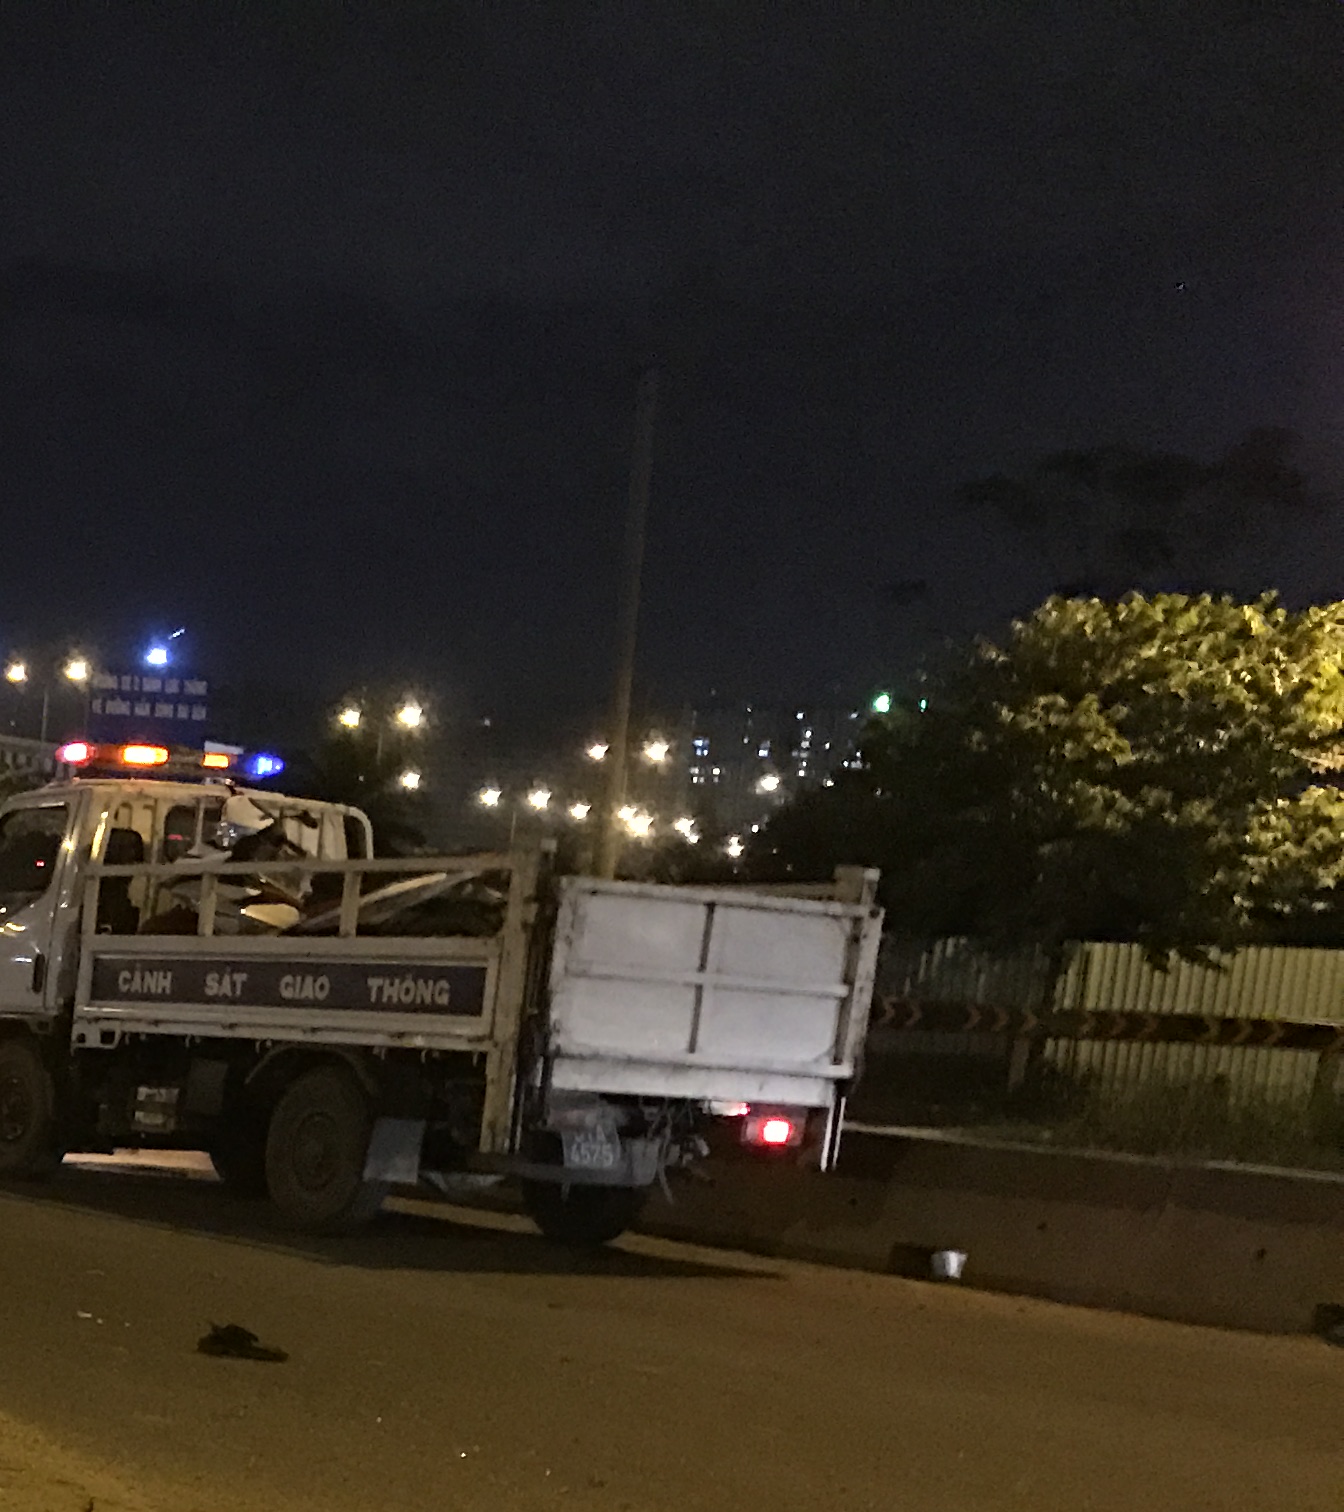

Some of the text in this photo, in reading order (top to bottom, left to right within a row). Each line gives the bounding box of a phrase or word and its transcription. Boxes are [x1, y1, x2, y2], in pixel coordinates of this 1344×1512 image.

[117, 963, 451, 1006] CẢNH SÁT GIAO THÔNG
[570, 1143, 614, 1168] 4575
